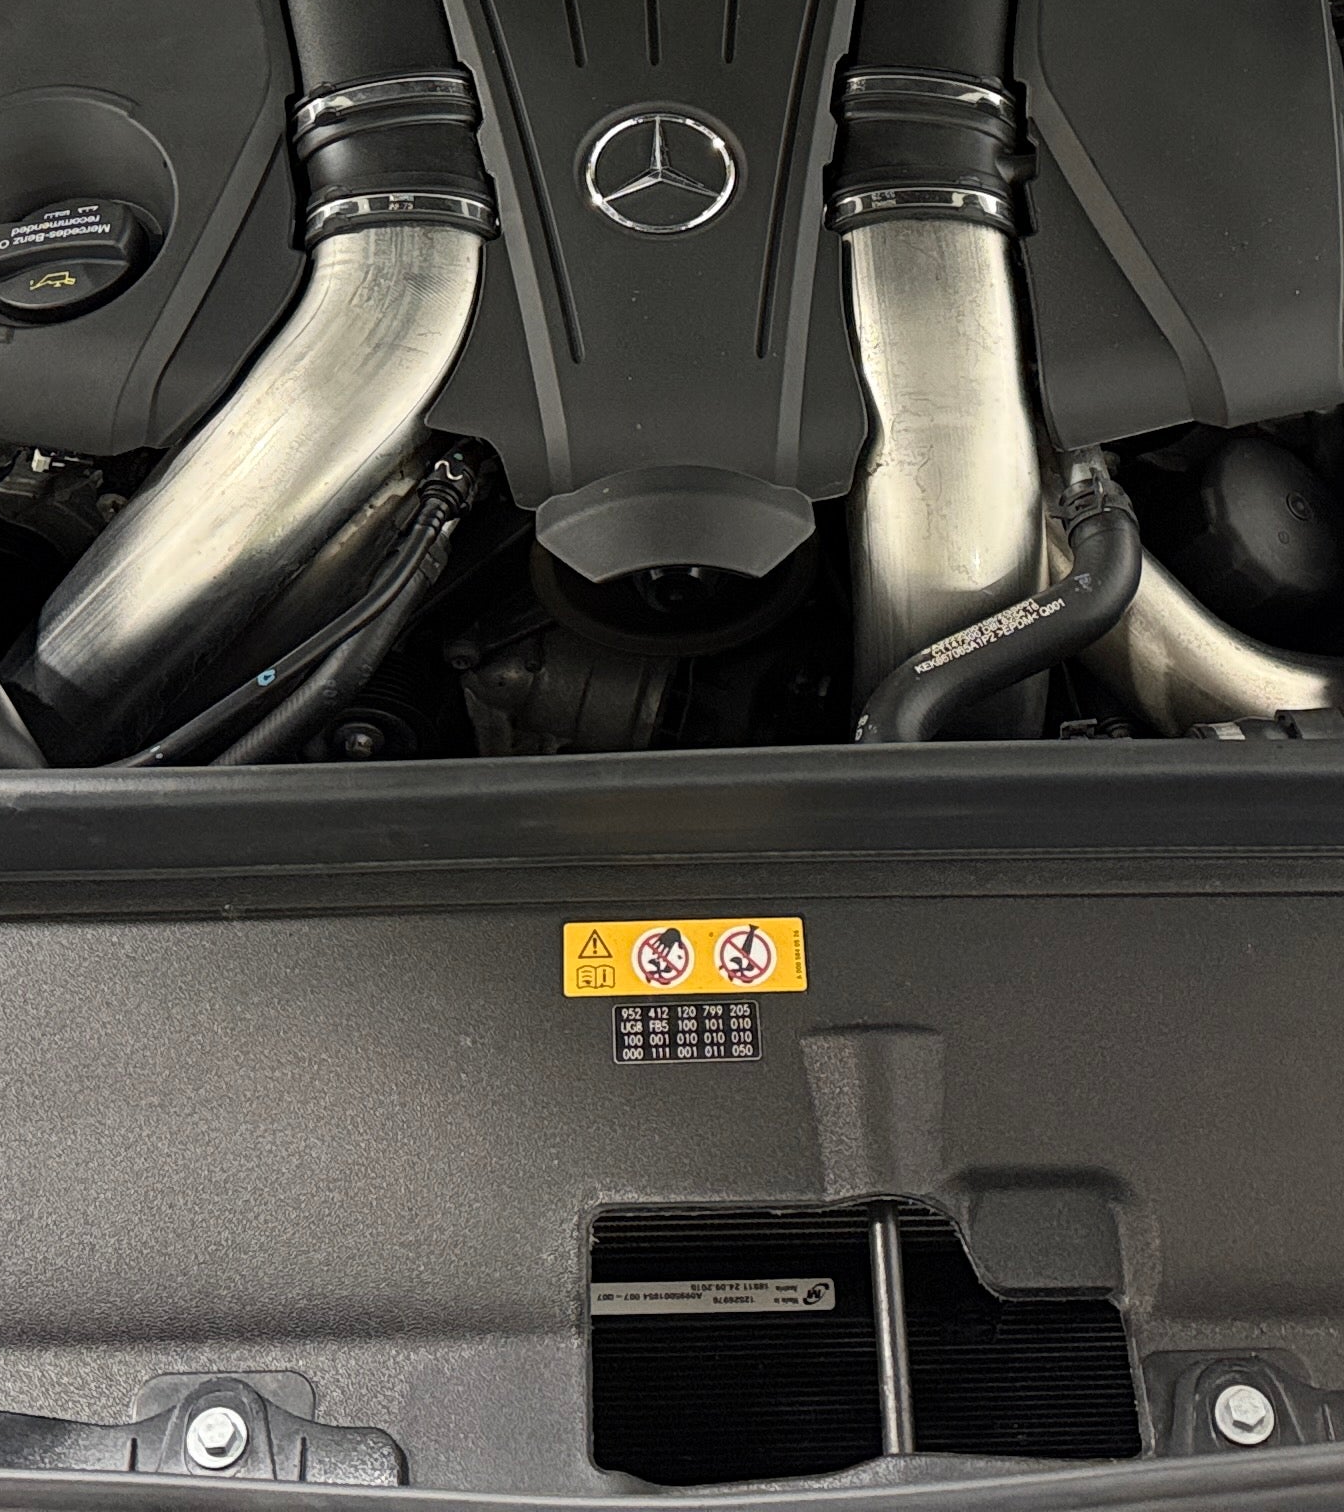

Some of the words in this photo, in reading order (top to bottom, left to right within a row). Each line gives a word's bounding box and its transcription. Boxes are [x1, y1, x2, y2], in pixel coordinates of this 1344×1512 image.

[11, 215, 100, 237] recommended
[13, 224, 110, 245] Mercedes-Benz
[621, 1008, 642, 1020] 952
[648, 1007, 669, 1019] 412
[677, 1006, 697, 1018] 120
[702, 1005, 723, 1017] 799
[729, 1004, 751, 1016] 205
[677, 1019, 697, 1031] 100
[705, 1018, 723, 1030] 101
[730, 1017, 752, 1030] 010
[624, 1034, 643, 1047] 100
[649, 1033, 670, 1046] 001
[676, 1032, 698, 1045] 010
[703, 1031, 725, 1044] 010
[731, 1031, 753, 1043] 010
[622, 1048, 644, 1060] 000
[651, 1047, 670, 1059] 111
[677, 1046, 697, 1058] 001
[704, 1045, 725, 1058] 011
[732, 1044, 754, 1057] 050
